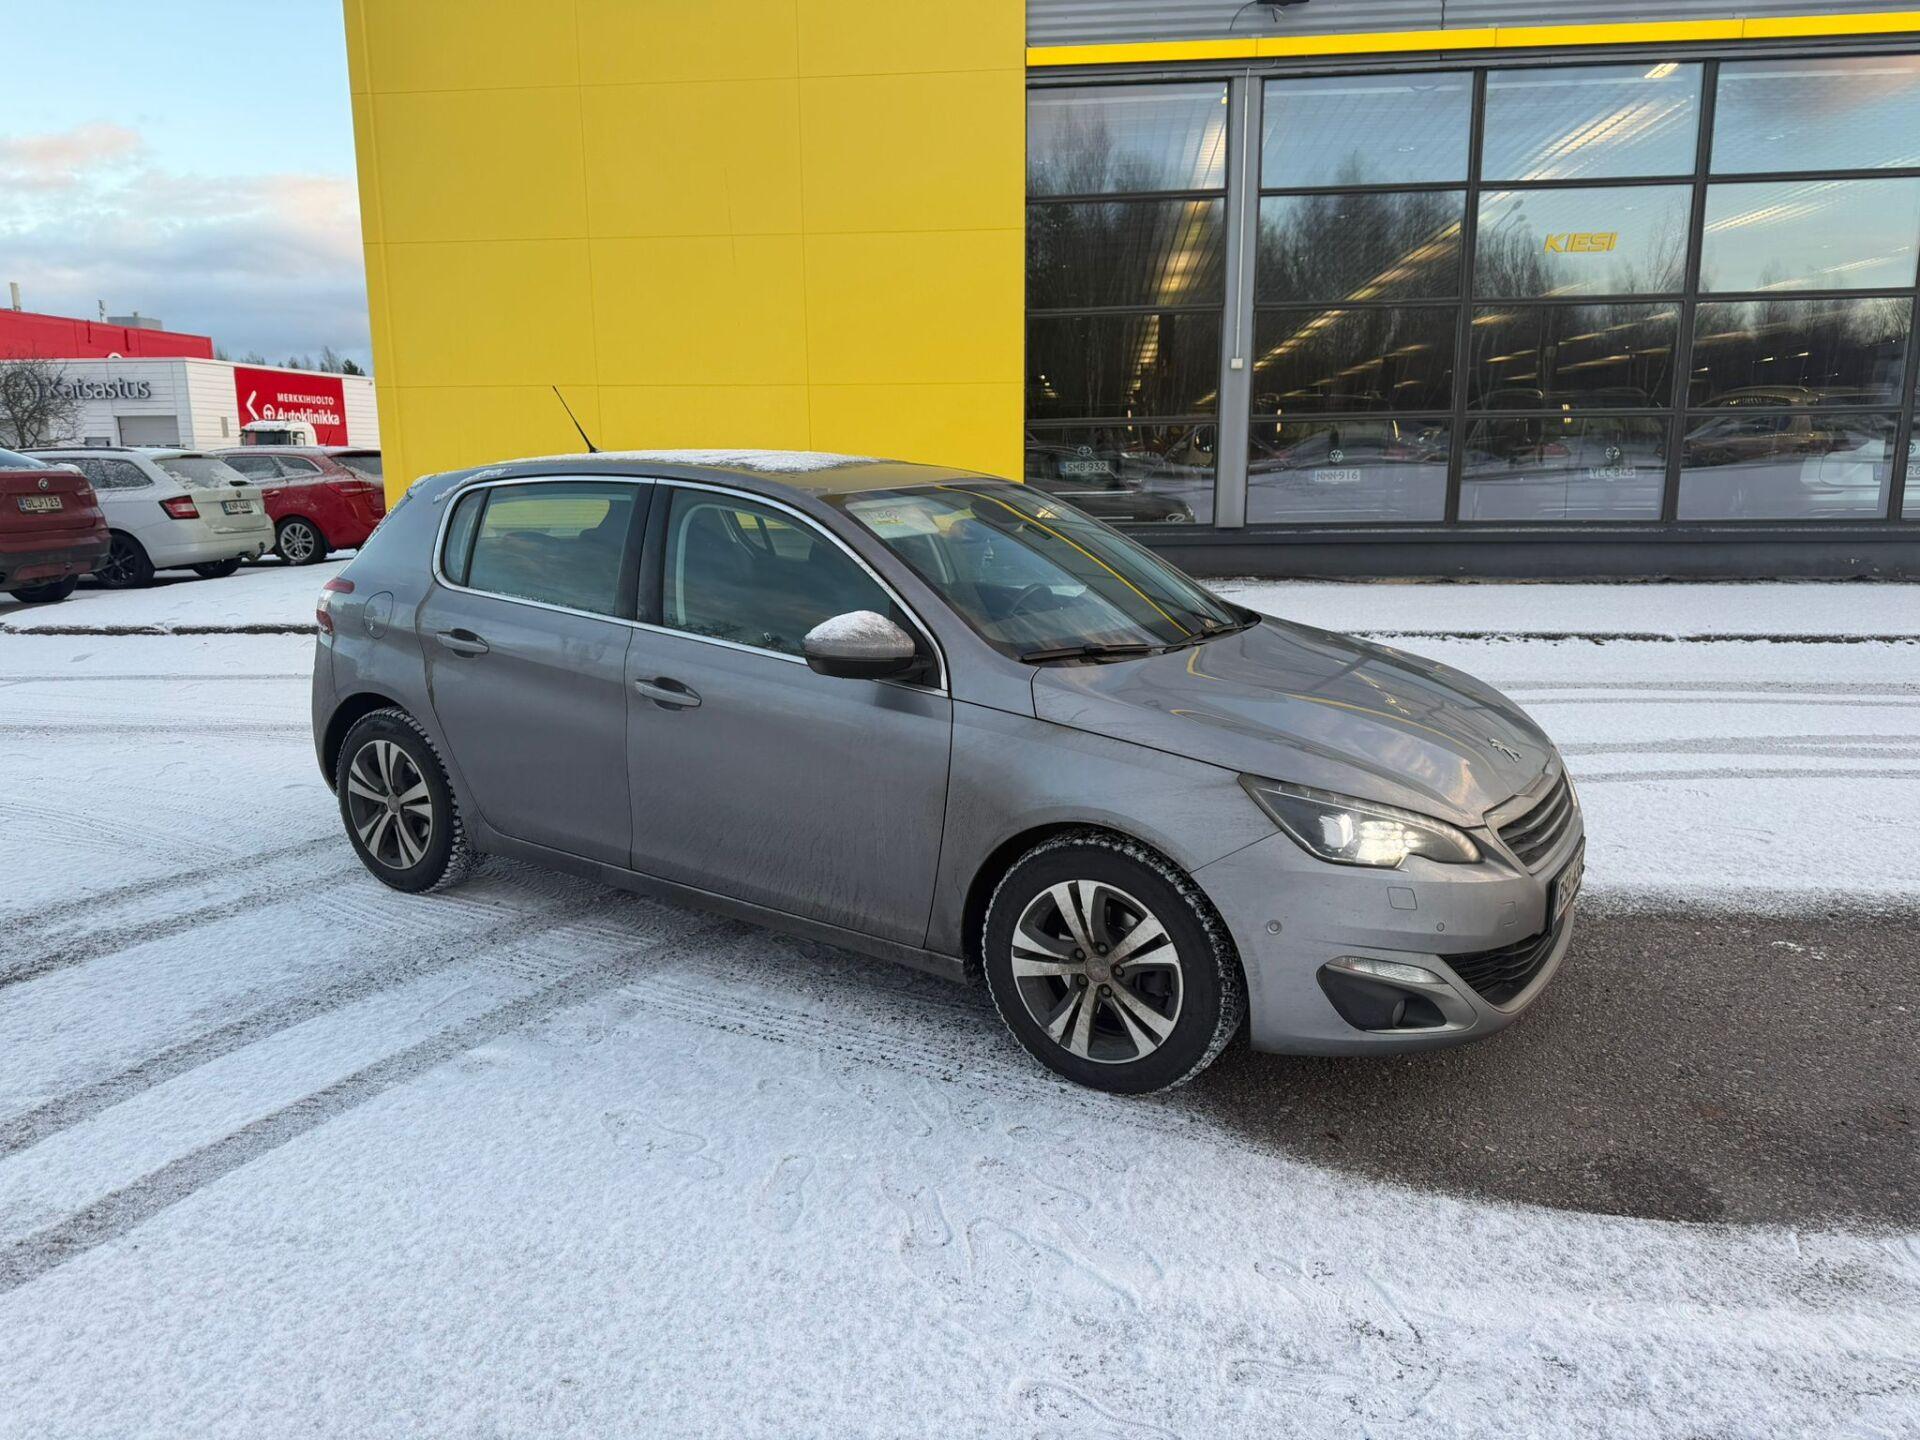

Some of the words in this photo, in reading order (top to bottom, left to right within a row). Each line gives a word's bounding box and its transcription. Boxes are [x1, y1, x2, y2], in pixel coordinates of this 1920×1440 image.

[1544, 232, 1617, 254] KIESI
[49, 377, 152, 401] Katsastus
[276, 393, 335, 406] MERKKIHUOLTO
[276, 407, 340, 425] Autoklinikka
